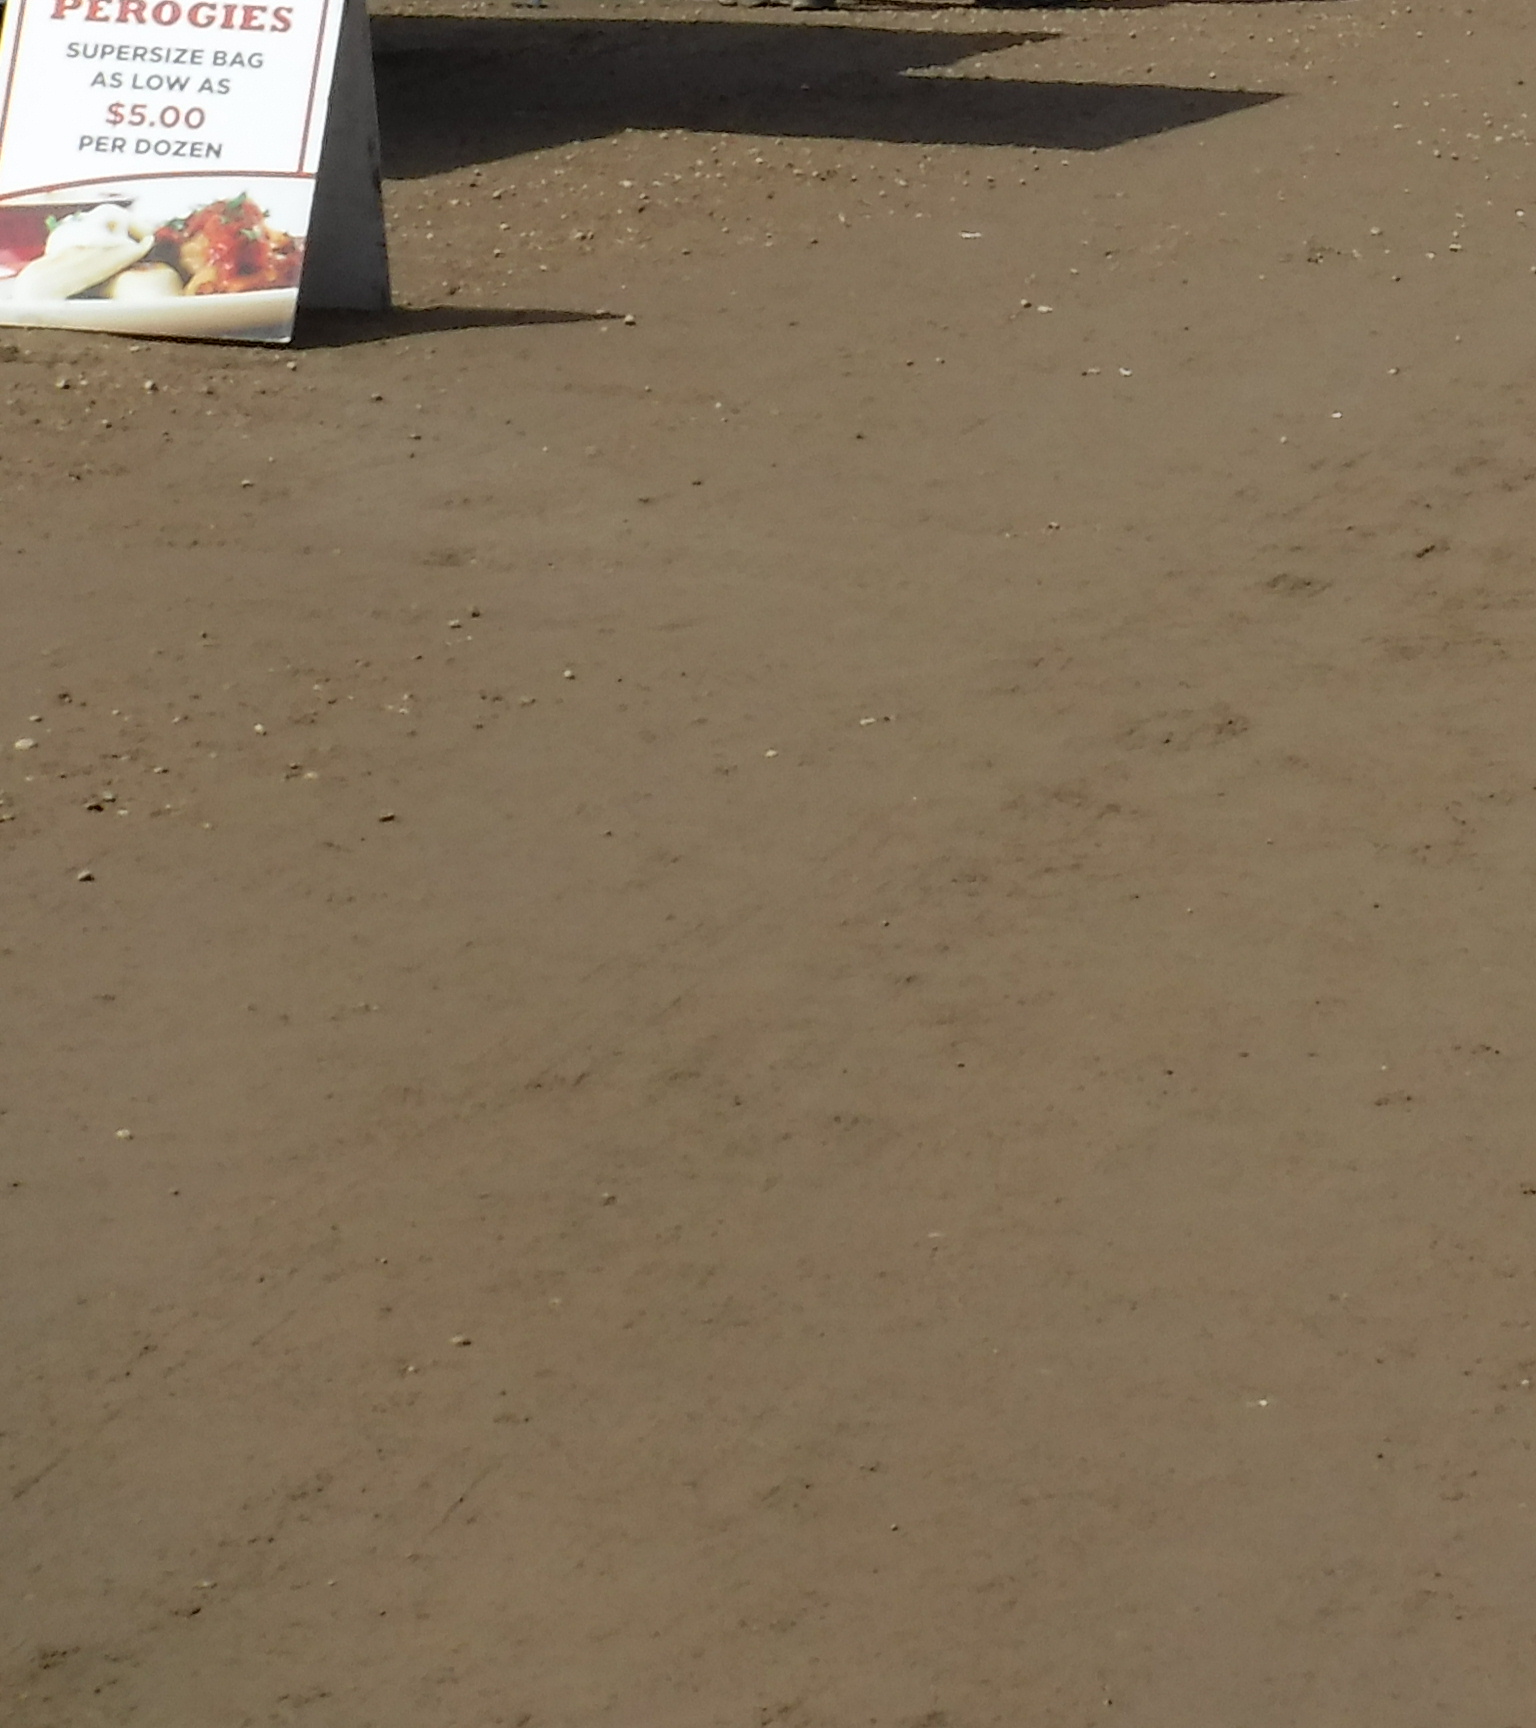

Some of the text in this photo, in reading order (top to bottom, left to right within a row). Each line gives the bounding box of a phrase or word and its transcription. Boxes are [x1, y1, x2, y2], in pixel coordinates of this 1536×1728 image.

[66, 41, 264, 69] SUPERSIZE BAG
[91, 71, 231, 95] AS LOW AS
[105, 101, 206, 130] $5.00
[78, 134, 223, 159] PER DOZEN
